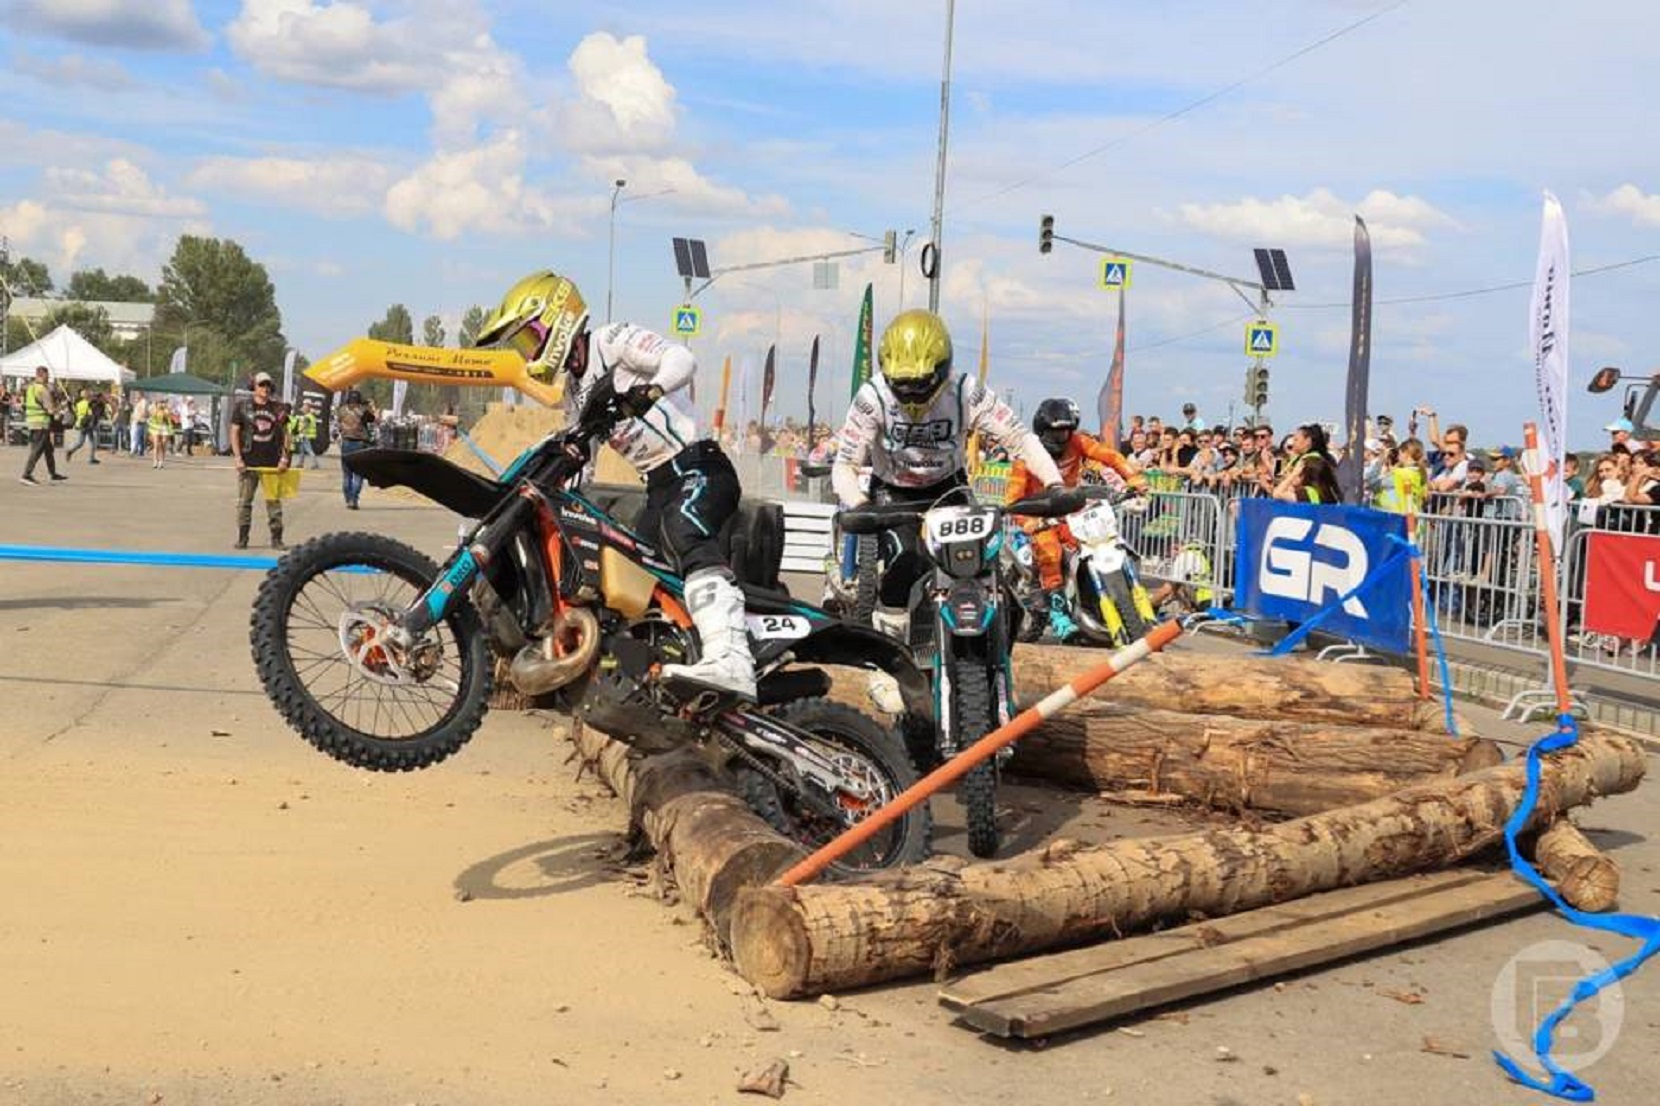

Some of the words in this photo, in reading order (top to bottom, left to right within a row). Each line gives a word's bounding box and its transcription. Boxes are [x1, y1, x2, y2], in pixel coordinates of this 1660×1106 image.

[940, 517, 985, 537] 888
[1260, 516, 1369, 619] GR
[763, 616, 796, 632] 24
